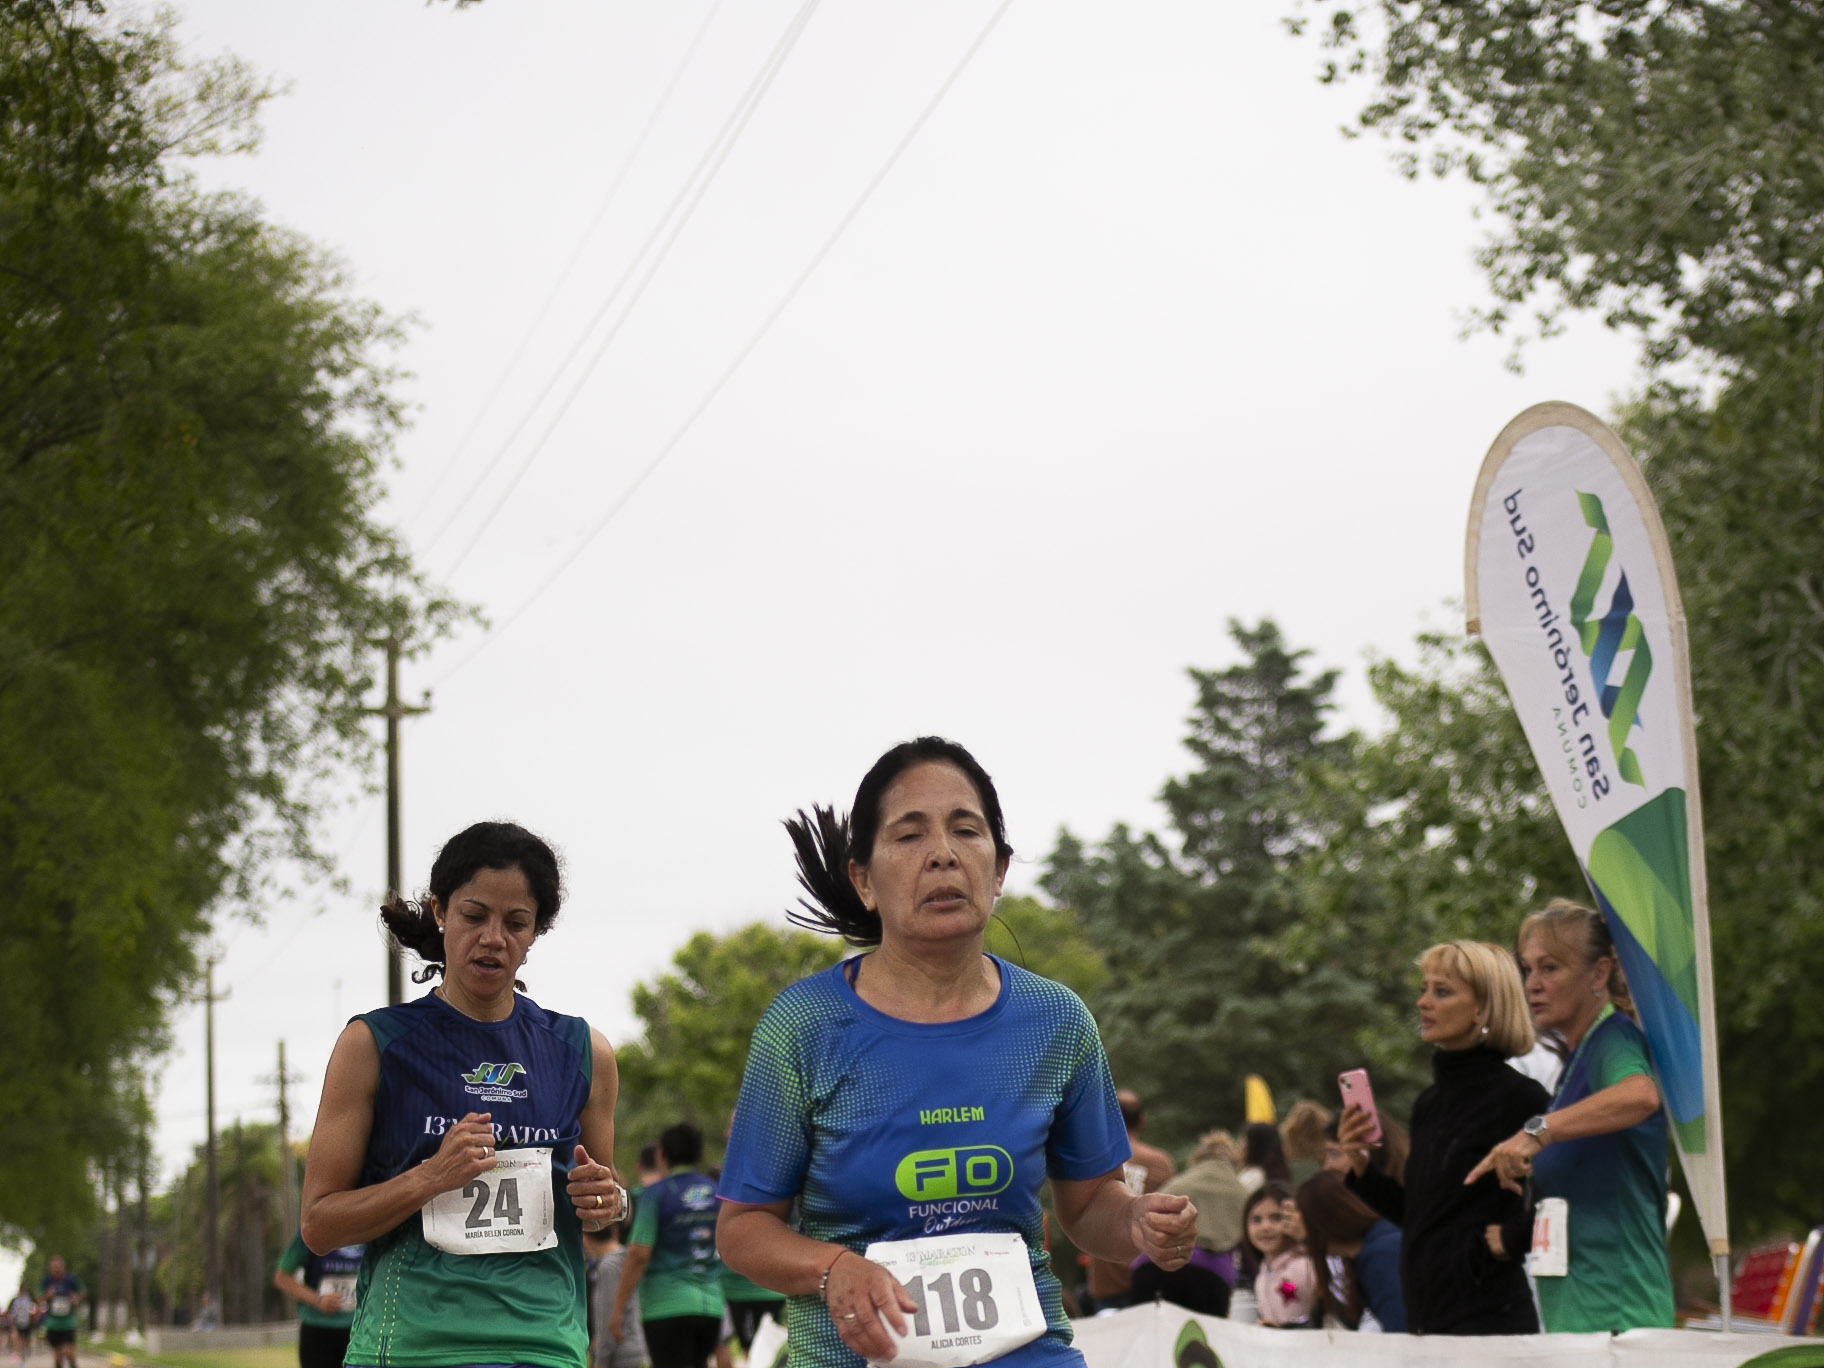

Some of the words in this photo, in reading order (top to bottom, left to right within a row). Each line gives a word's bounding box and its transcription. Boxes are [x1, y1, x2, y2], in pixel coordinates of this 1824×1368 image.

[513, 1089, 528, 1098] Sud
[920, 1106, 985, 1125] HARLEM
[462, 1178, 523, 1229] 24
[909, 1199, 999, 1219] FUNCIONAL
[465, 1229, 483, 1239] MARÍA
[484, 1229, 502, 1238] BELEN
[502, 1228, 525, 1237] CORONA
[903, 1268, 999, 1337] 118
[931, 1337, 955, 1350] ALICIA
[954, 1335, 982, 1348] CORTES
